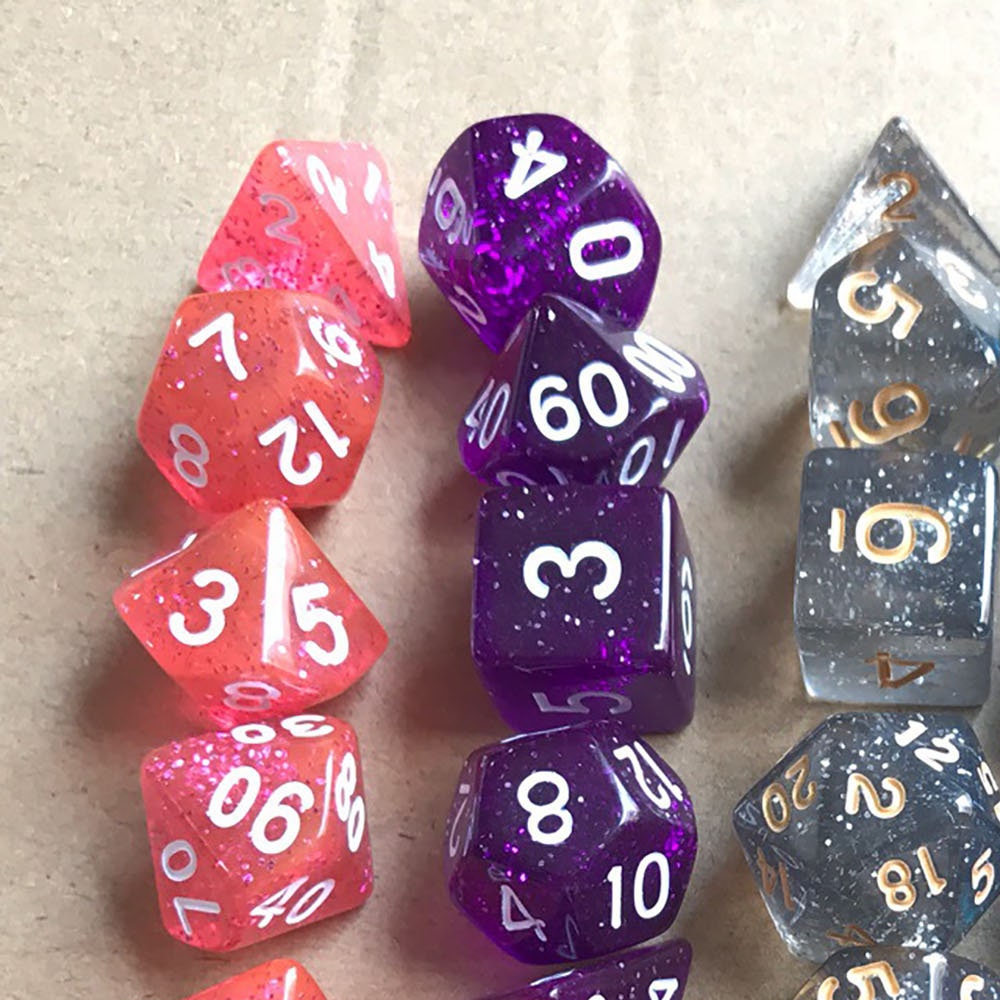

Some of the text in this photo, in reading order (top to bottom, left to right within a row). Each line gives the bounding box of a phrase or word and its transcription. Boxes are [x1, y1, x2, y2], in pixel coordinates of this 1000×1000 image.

[306, 155, 347, 214] 2
[504, 127, 567, 200] 4
[879, 170, 919, 222] 2
[260, 193, 302, 243] 2
[569, 220, 644, 281] 0
[837, 270, 923, 340] 5
[188, 312, 248, 381] 7
[529, 361, 630, 442] 60
[170, 423, 210, 488] 8
[258, 400, 350, 486] 12
[523, 540, 622, 600] 3
[168, 569, 239, 646] 3
[291, 582, 349, 666] 5
[532, 691, 632, 715] 5
[613, 741, 684, 810] 12
[894, 720, 960, 773] 12
[517, 770, 573, 845] 8
[761, 755, 816, 834] 20
[845, 773, 907, 819] 2
[161, 840, 221, 936] 70
[250, 876, 336, 928] 40
[607, 851, 670, 930] 10
[877, 846, 947, 912] 18
[500, 885, 547, 942] 4
